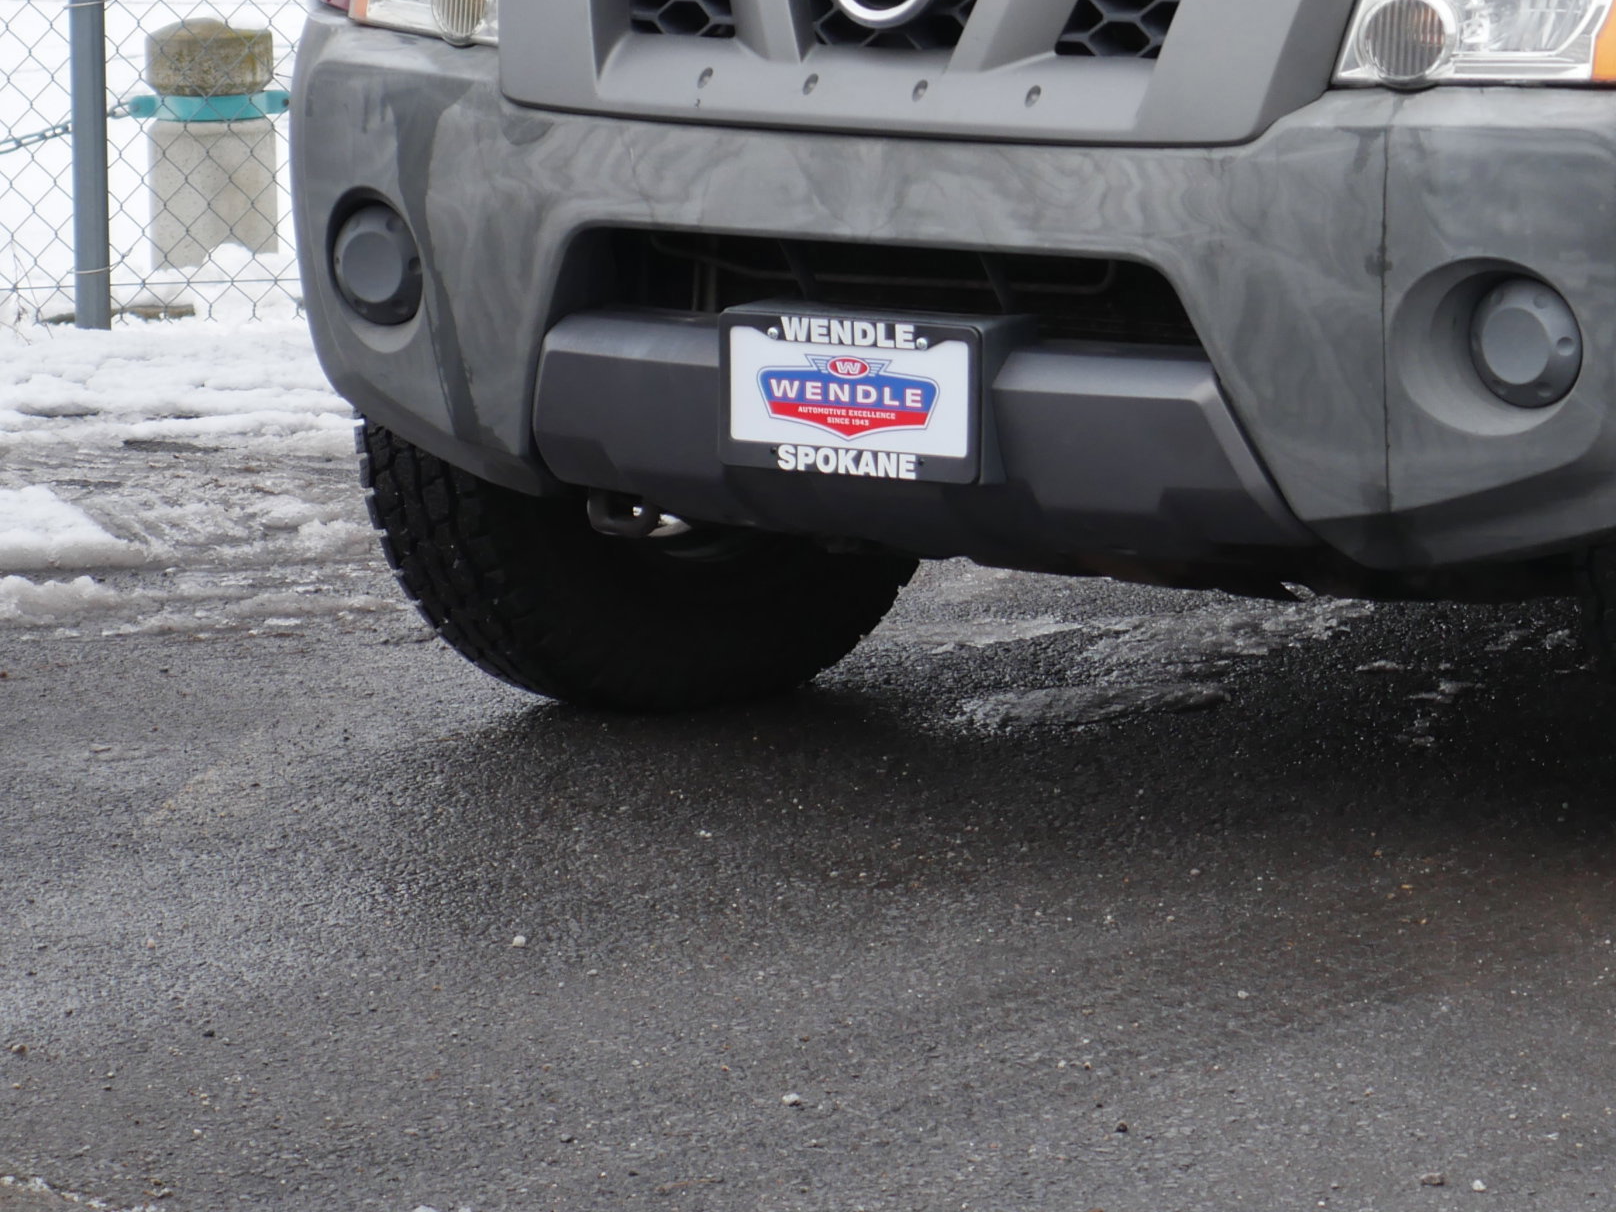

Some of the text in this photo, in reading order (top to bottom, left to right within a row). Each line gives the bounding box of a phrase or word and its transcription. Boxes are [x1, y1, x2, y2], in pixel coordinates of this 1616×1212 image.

[780, 316, 916, 350] WENDLE
[770, 378, 923, 408] WENDLE
[797, 406, 896, 420] AUTOMOTIVE EXCELLENCE
[826, 416, 850, 425] SINCE
[777, 444, 916, 480] SPOKANE
